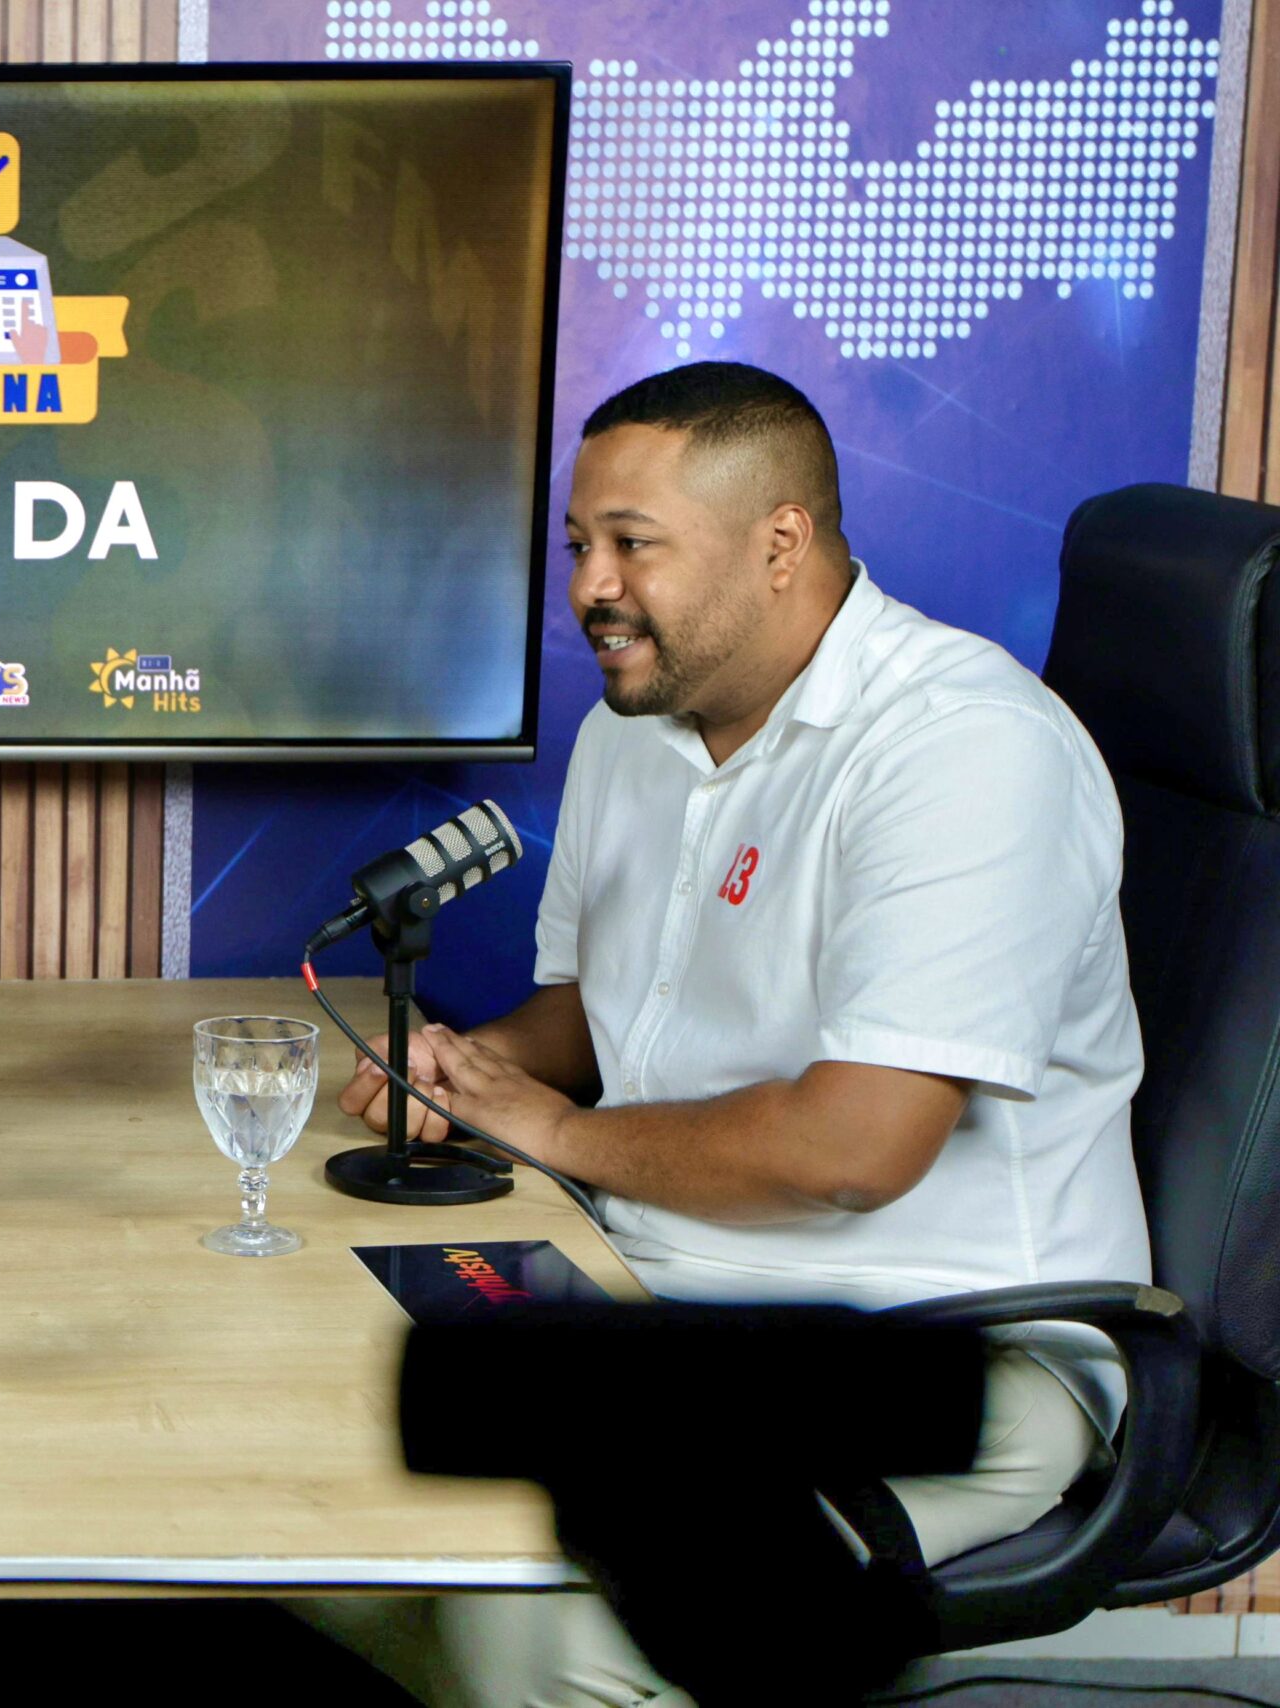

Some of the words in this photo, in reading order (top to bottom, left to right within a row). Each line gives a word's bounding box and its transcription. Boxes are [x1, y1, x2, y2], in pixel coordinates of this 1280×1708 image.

[115, 668, 200, 691] Manhã
[2, 696, 28, 704] NEWS
[153, 692, 201, 712] Hits
